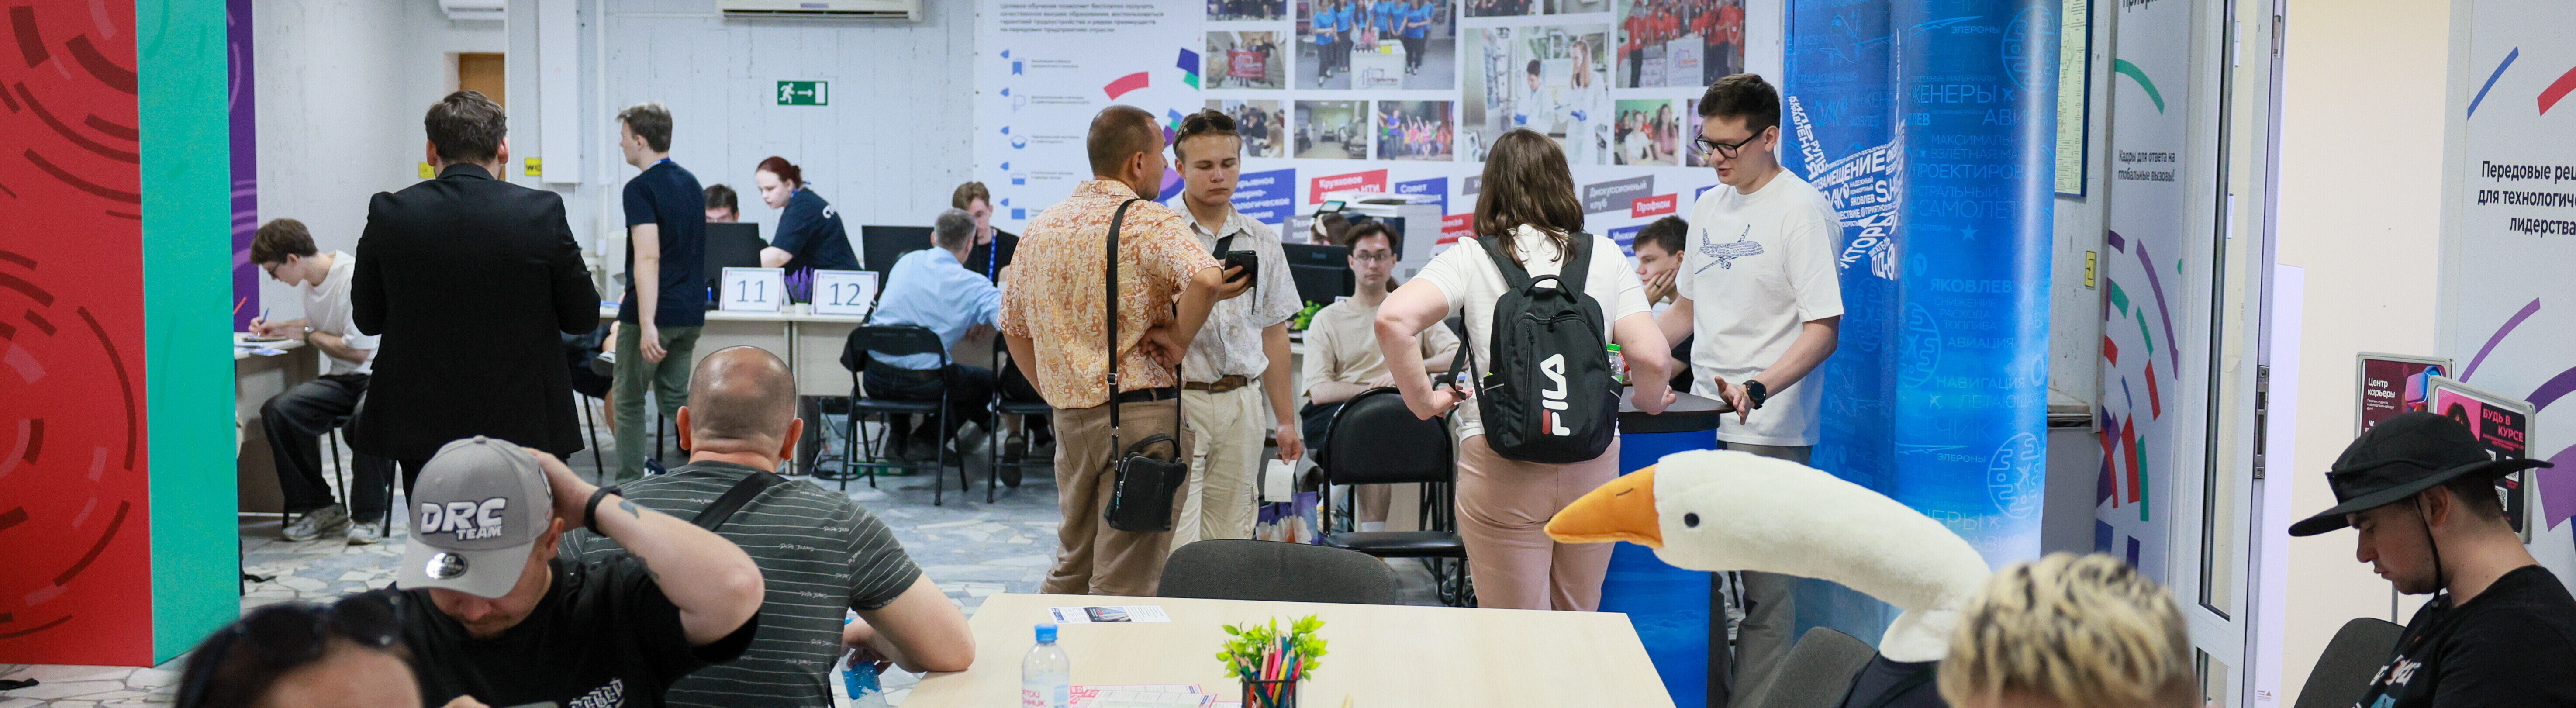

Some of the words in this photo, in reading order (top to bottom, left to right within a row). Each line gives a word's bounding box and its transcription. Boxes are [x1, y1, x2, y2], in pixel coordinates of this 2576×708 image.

[1950, 26, 2000, 34] ЭЛЕРОНЫ
[2119, 150, 2136, 165] Кадры
[2137, 152, 2148, 163] для
[2148, 152, 2167, 162] ответа
[2168, 152, 2175, 162] на
[2118, 167, 2150, 181] глобальные
[2151, 169, 2175, 182] вызовы!
[2482, 160, 2552, 183] Передовые
[1319, 176, 1363, 190] Кружковое
[1399, 183, 1428, 194] Совет
[1589, 181, 1647, 197] Дискуссионный
[1589, 199, 1608, 211] клуб
[1636, 198, 1671, 214] Профком
[2477, 190, 2500, 205] для
[2502, 190, 2576, 207] технологич
[2509, 217, 2576, 238] лидерства
[736, 280, 767, 303] 11
[1930, 277, 2012, 293] ЯКОВЛЕВ
[829, 283, 860, 306] 12
[1934, 297, 1997, 307] СНИЖЕНИЕ
[1939, 308, 1991, 318] РАСХОДА
[1943, 319, 1997, 331] ТОПЛИВА
[1947, 336, 2015, 349] АВИАЦИЯ
[1936, 375, 2026, 390] НАВИГАЦИЯ
[2368, 377, 2388, 389] Центр
[1540, 353, 1571, 436] FILA
[2367, 389, 2396, 399] карьеры
[2483, 408, 2503, 424] БУДЬ
[2505, 415, 2511, 426] В
[2498, 425, 2524, 442] КУРСЕ
[1937, 452, 1986, 463] ЭЛЕРОНЫ
[420, 497, 508, 534] DRC
[456, 525, 502, 541] TEAM
